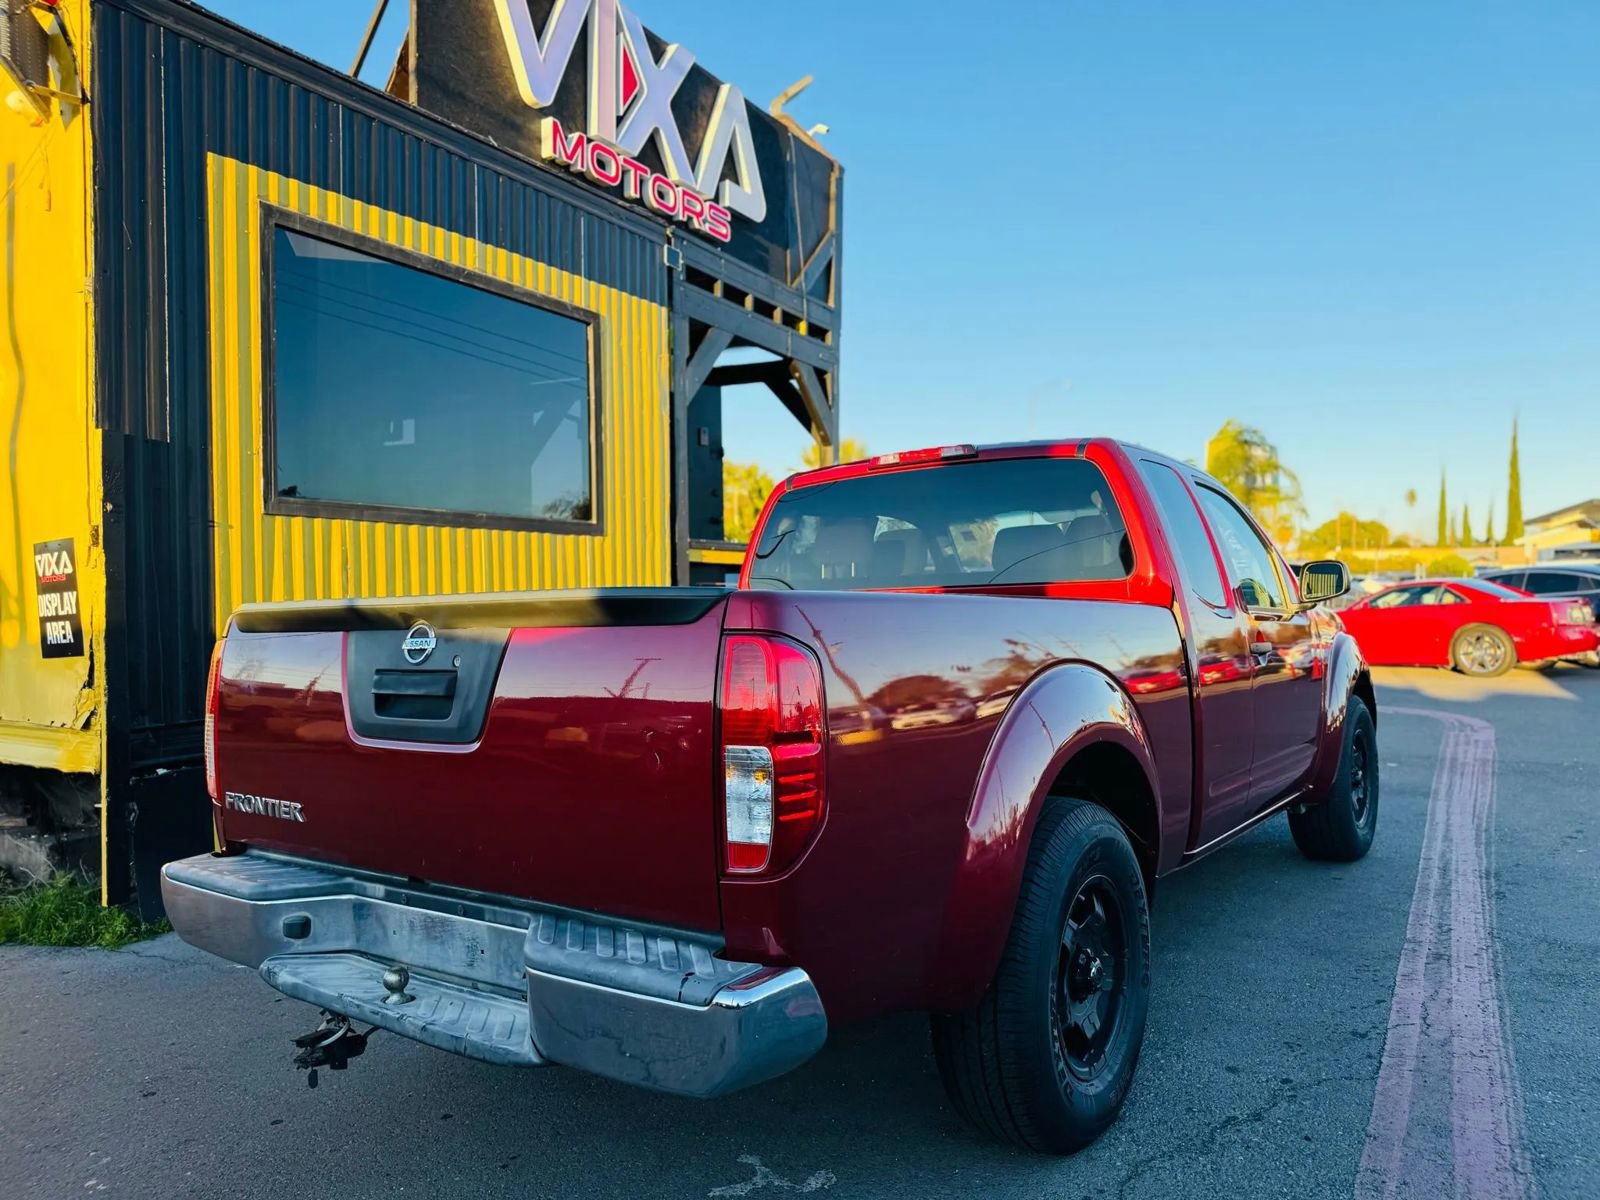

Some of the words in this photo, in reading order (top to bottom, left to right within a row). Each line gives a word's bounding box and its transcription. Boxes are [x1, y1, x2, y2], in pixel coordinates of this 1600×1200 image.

[493, 0, 767, 223] VIXA
[546, 117, 731, 242] MOTORS
[35, 550, 74, 577] VIXA
[37, 591, 77, 617] DISPLAY
[46, 620, 75, 645] AREA
[225, 791, 305, 823] FRONTIER
